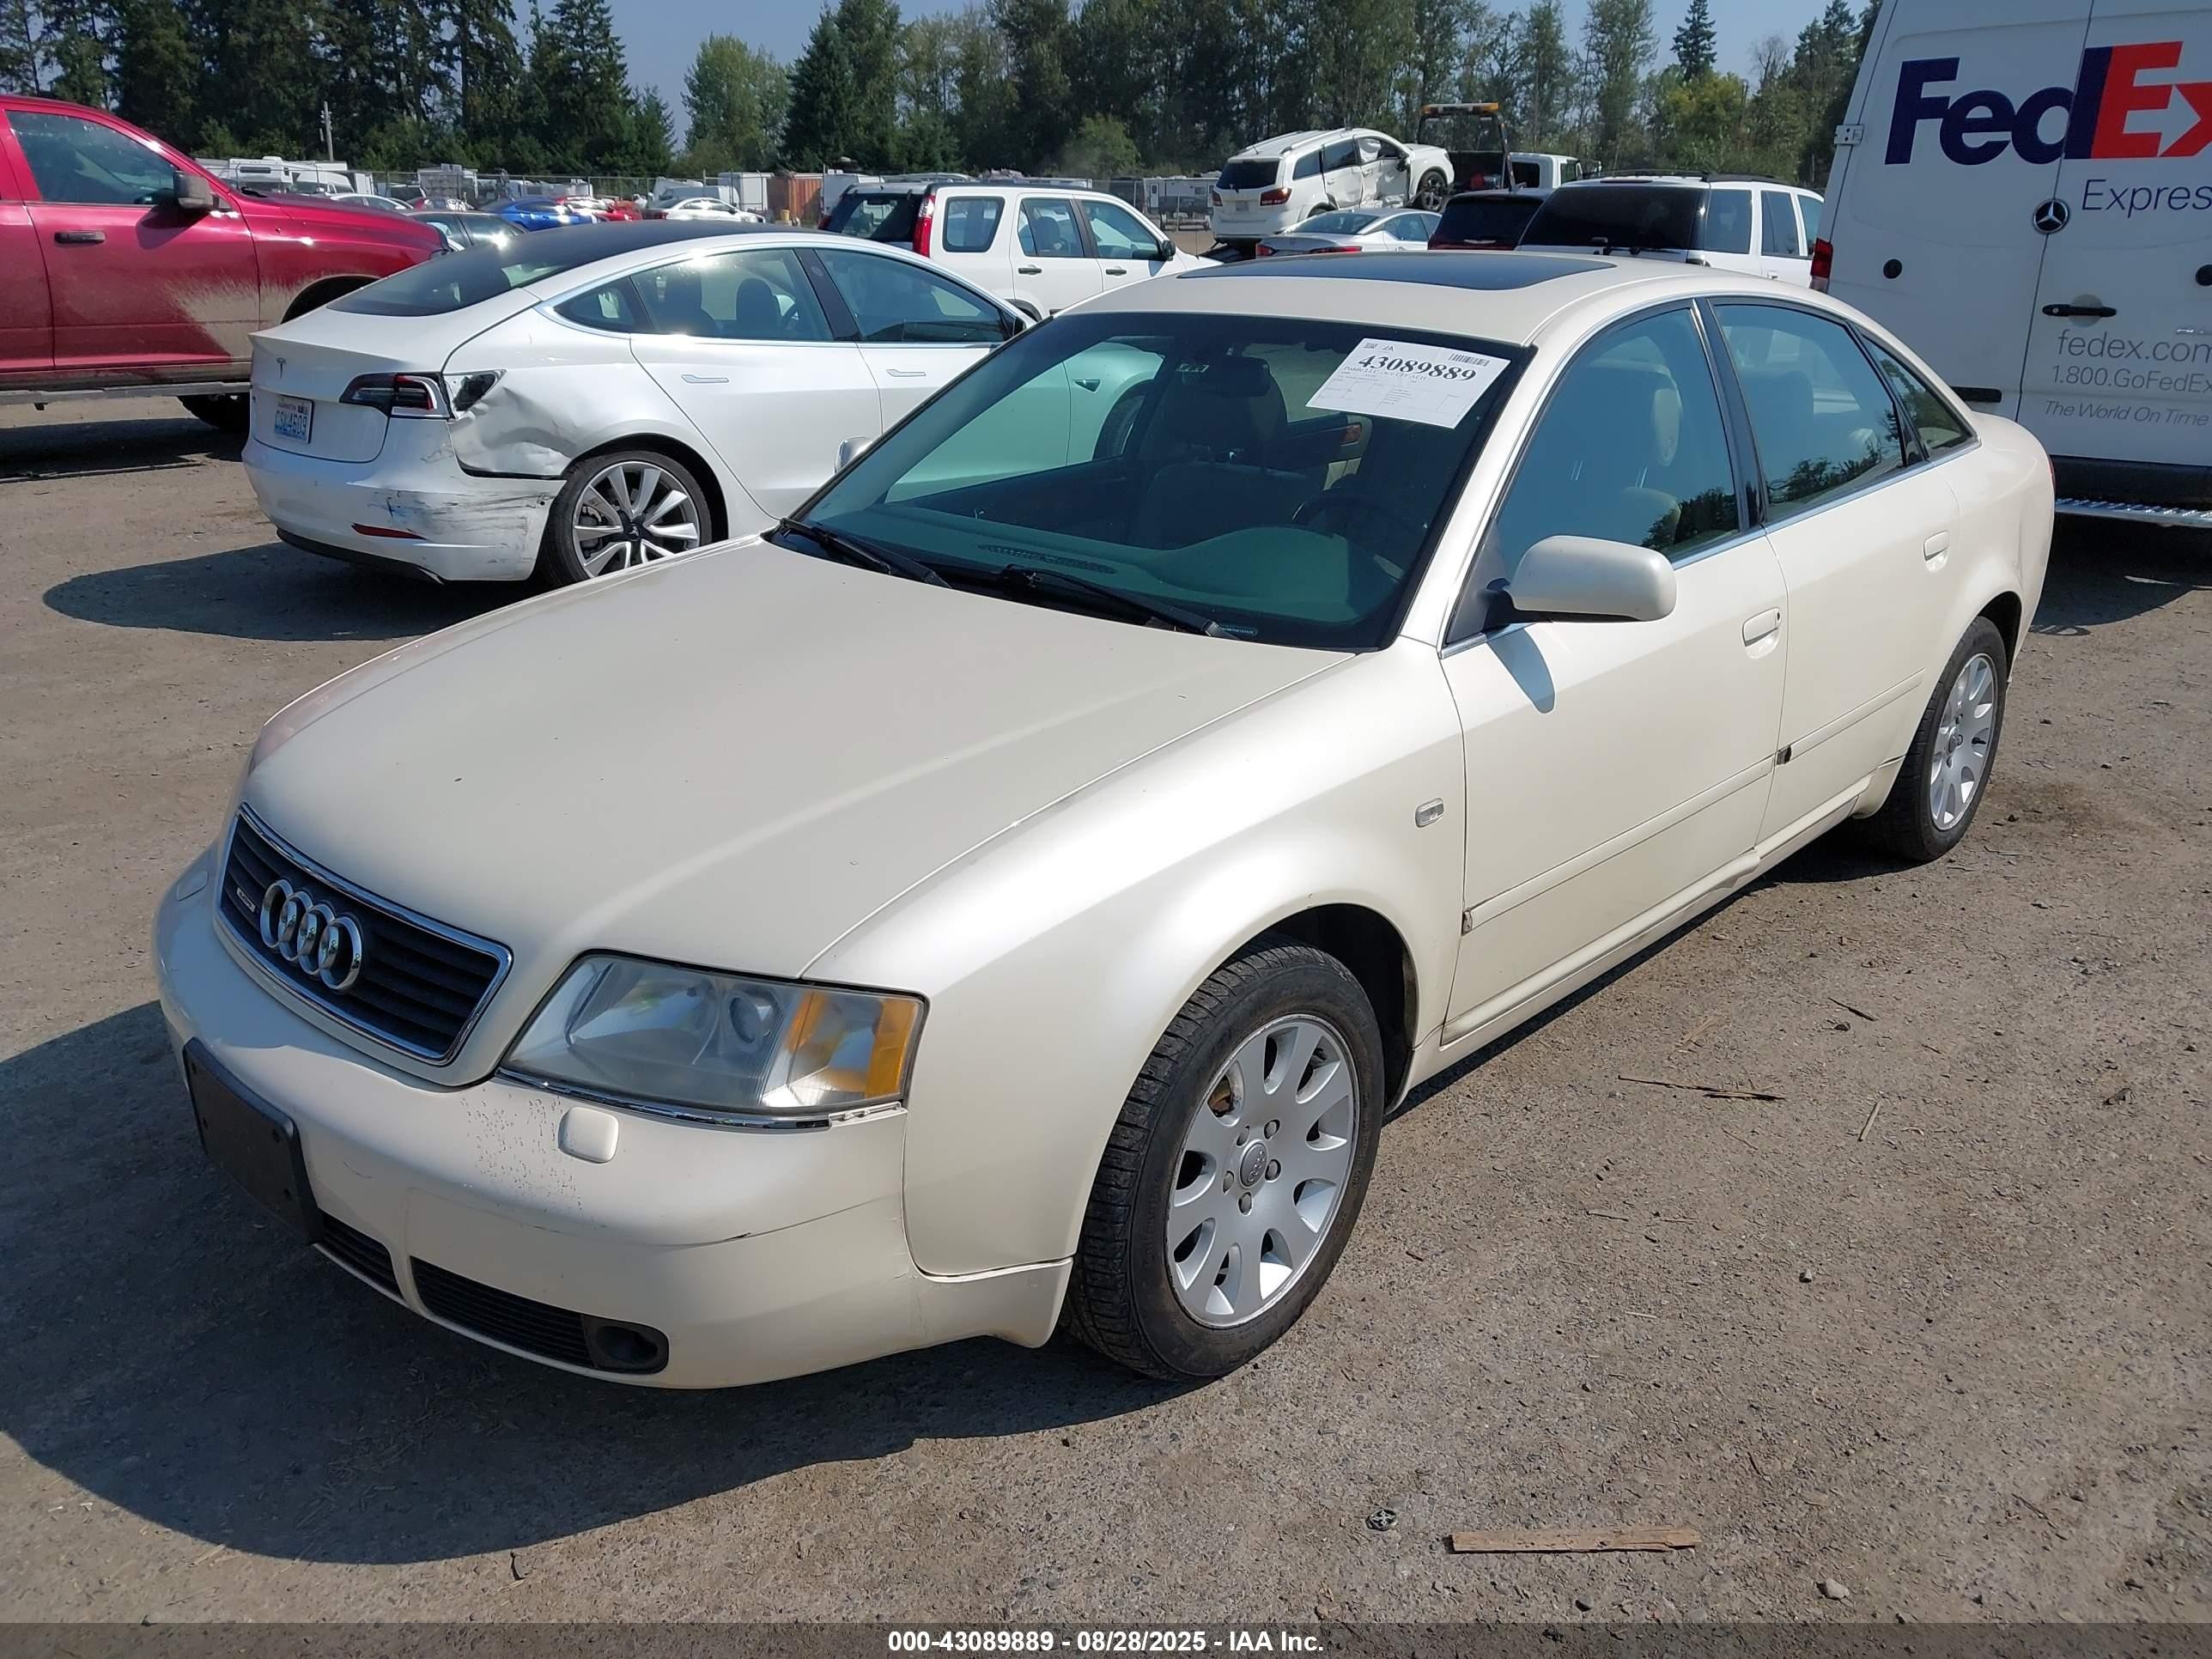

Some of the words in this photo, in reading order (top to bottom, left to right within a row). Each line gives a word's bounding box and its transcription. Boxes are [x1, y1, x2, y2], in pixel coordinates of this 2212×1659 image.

[2081, 178, 2212, 218] Expres
[2057, 329, 2212, 363] fedex.com
[1358, 355, 1476, 381] 43089889
[2045, 399, 2075, 416] The
[2079, 403, 2131, 420] World
[2134, 406, 2160, 422] On
[2165, 408, 2209, 426] Time
